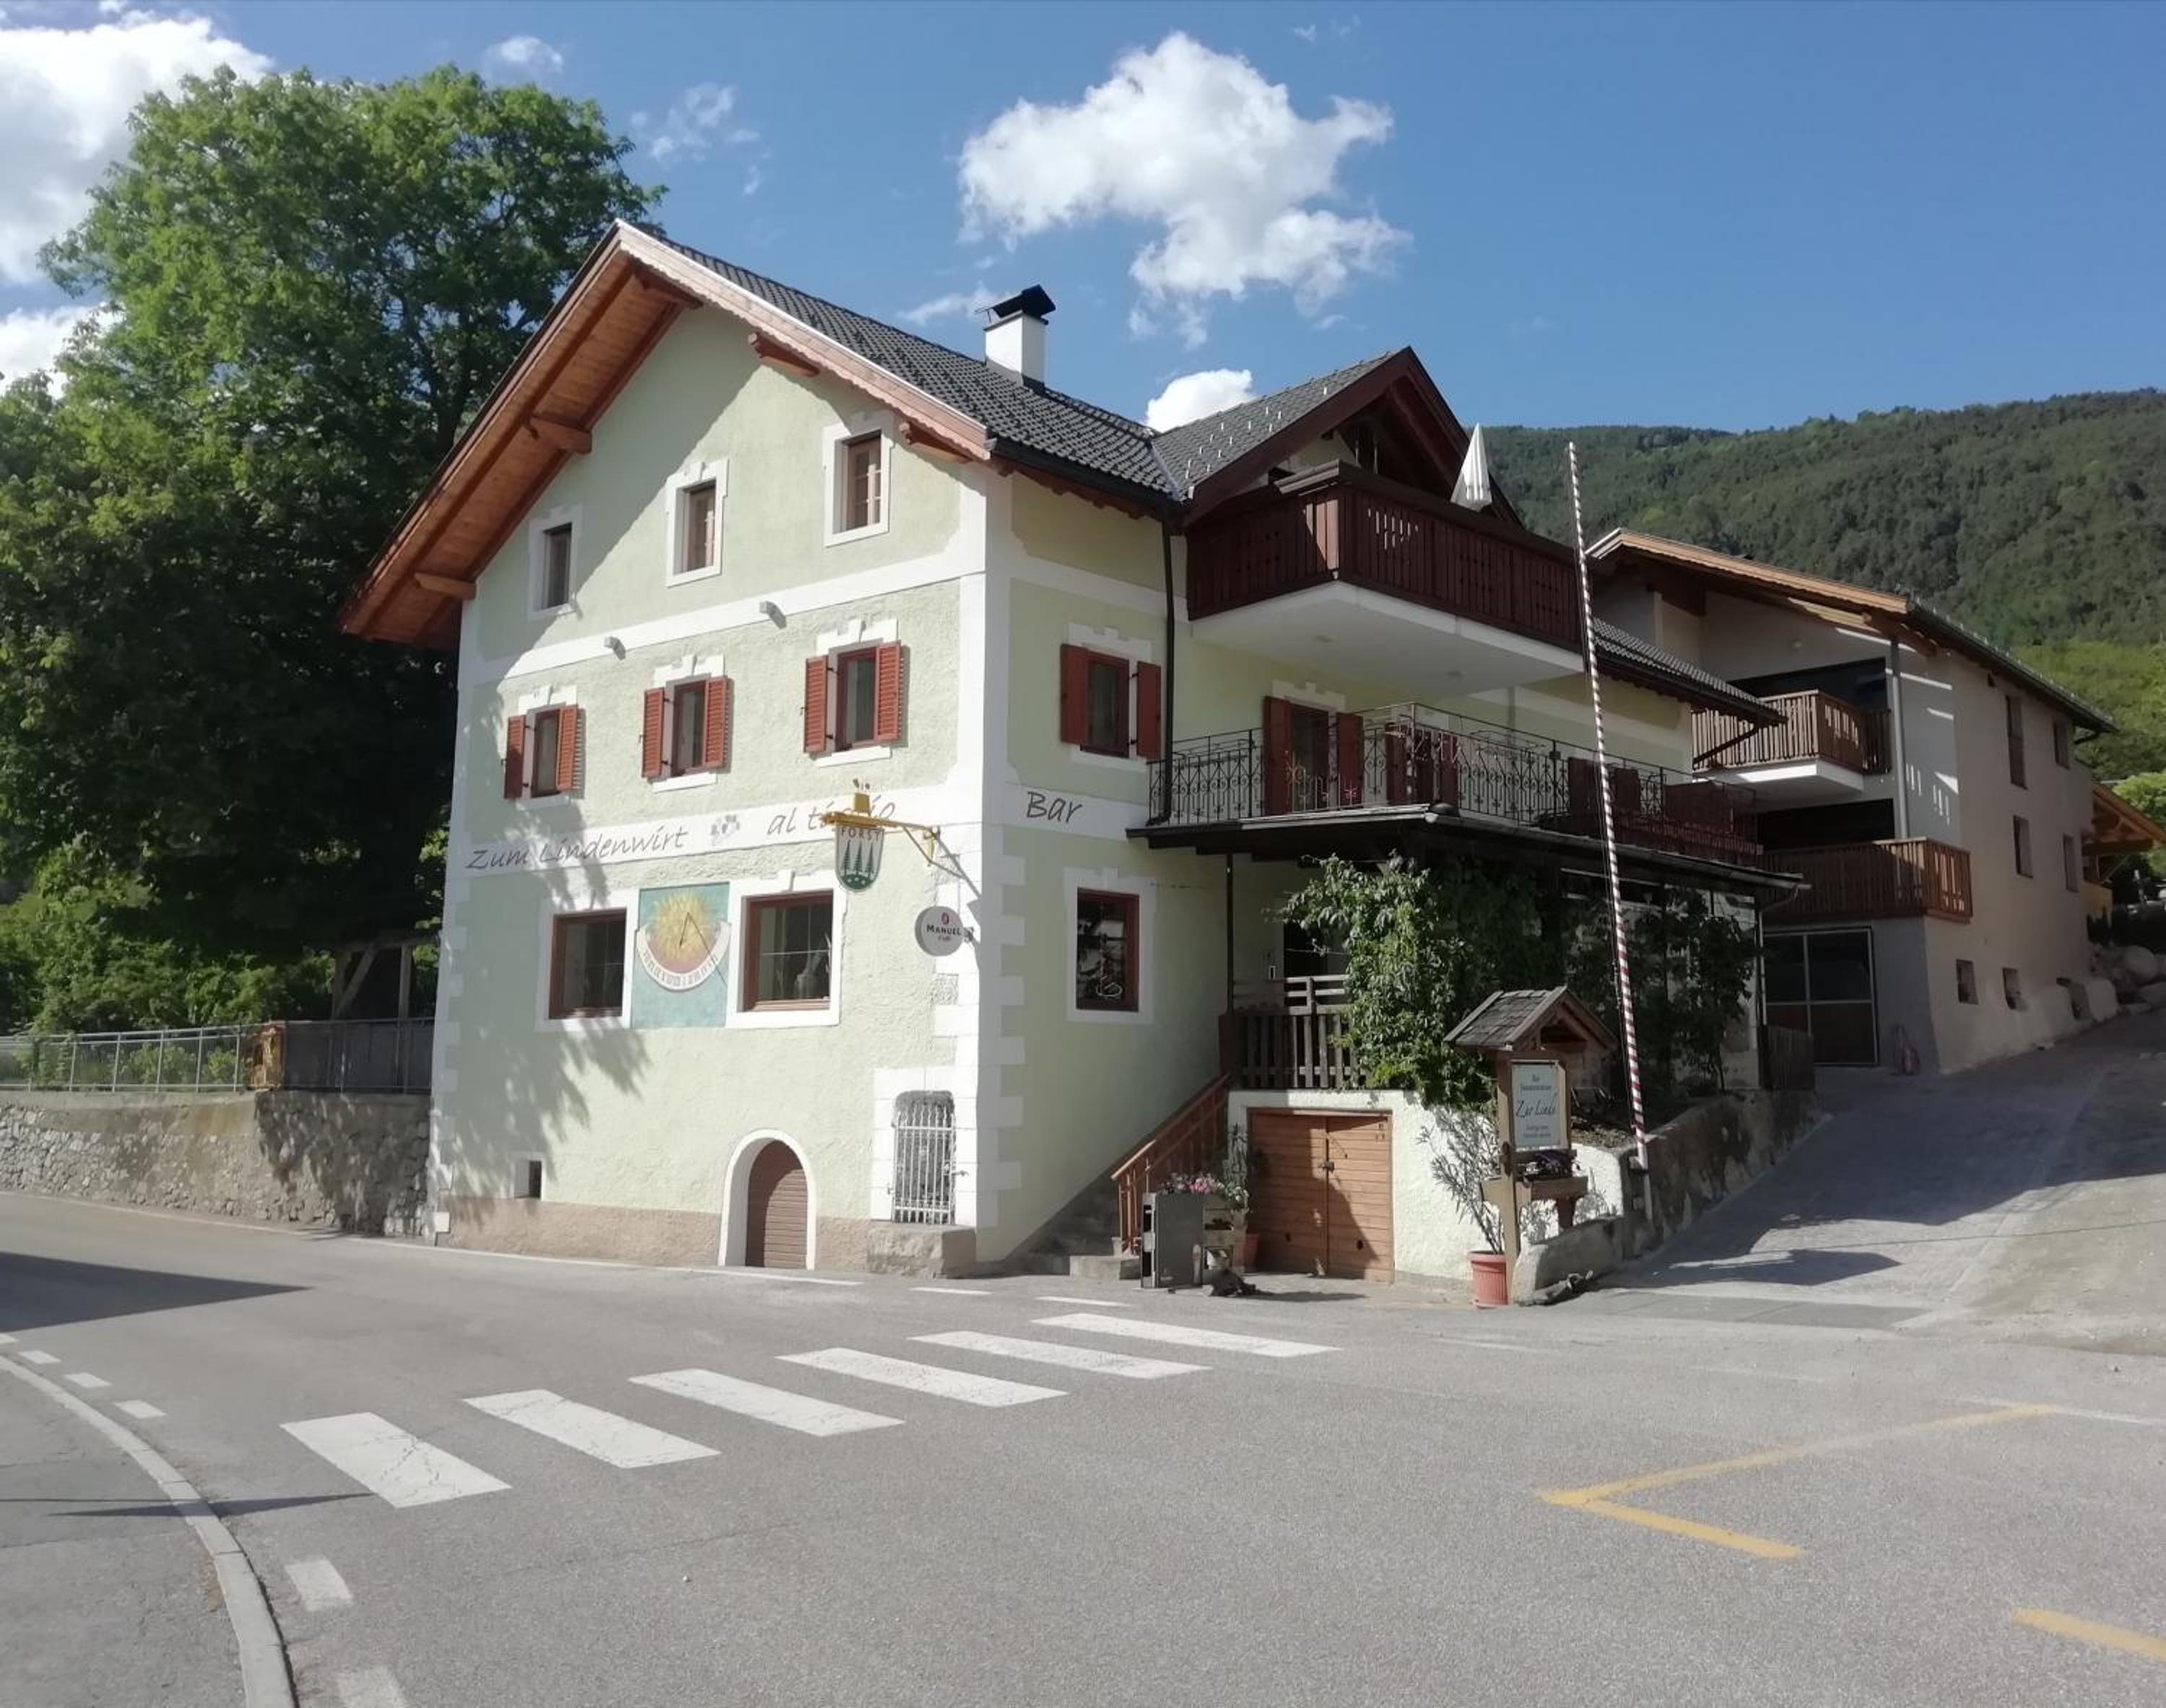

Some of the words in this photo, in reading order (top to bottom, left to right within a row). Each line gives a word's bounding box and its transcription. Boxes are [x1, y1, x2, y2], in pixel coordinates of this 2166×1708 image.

[1025, 790, 1083, 824] Bar
[466, 848, 529, 869] Zum
[539, 825, 689, 864] Lindenwirt
[767, 806, 798, 836] al
[841, 827, 881, 841] FORST
[926, 923, 962, 936] MANUEL
